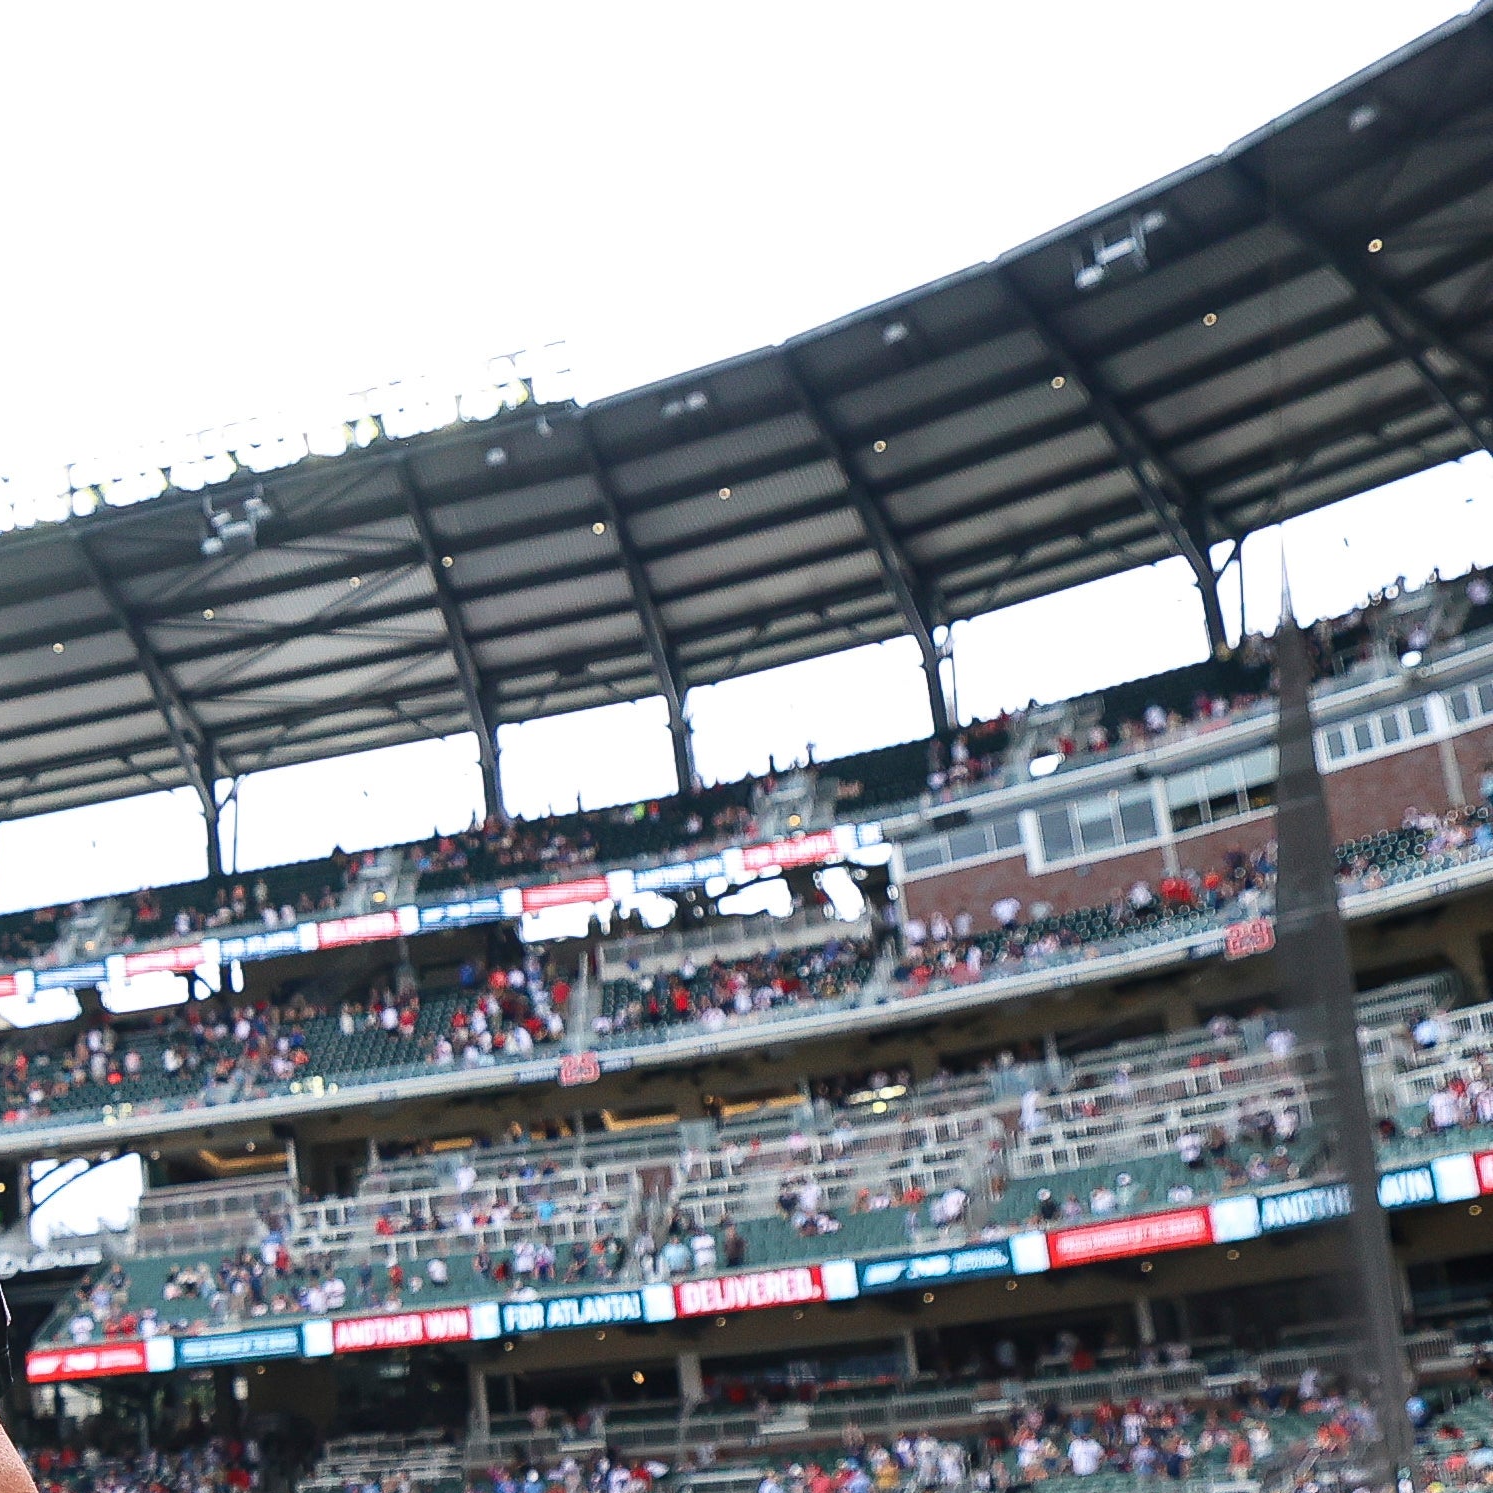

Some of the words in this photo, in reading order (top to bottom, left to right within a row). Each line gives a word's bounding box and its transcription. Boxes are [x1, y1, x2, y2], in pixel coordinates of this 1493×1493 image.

[338, 1314, 423, 1349] ANOTHER
[425, 1308, 469, 1342] WIN
[503, 1302, 545, 1332] FOR
